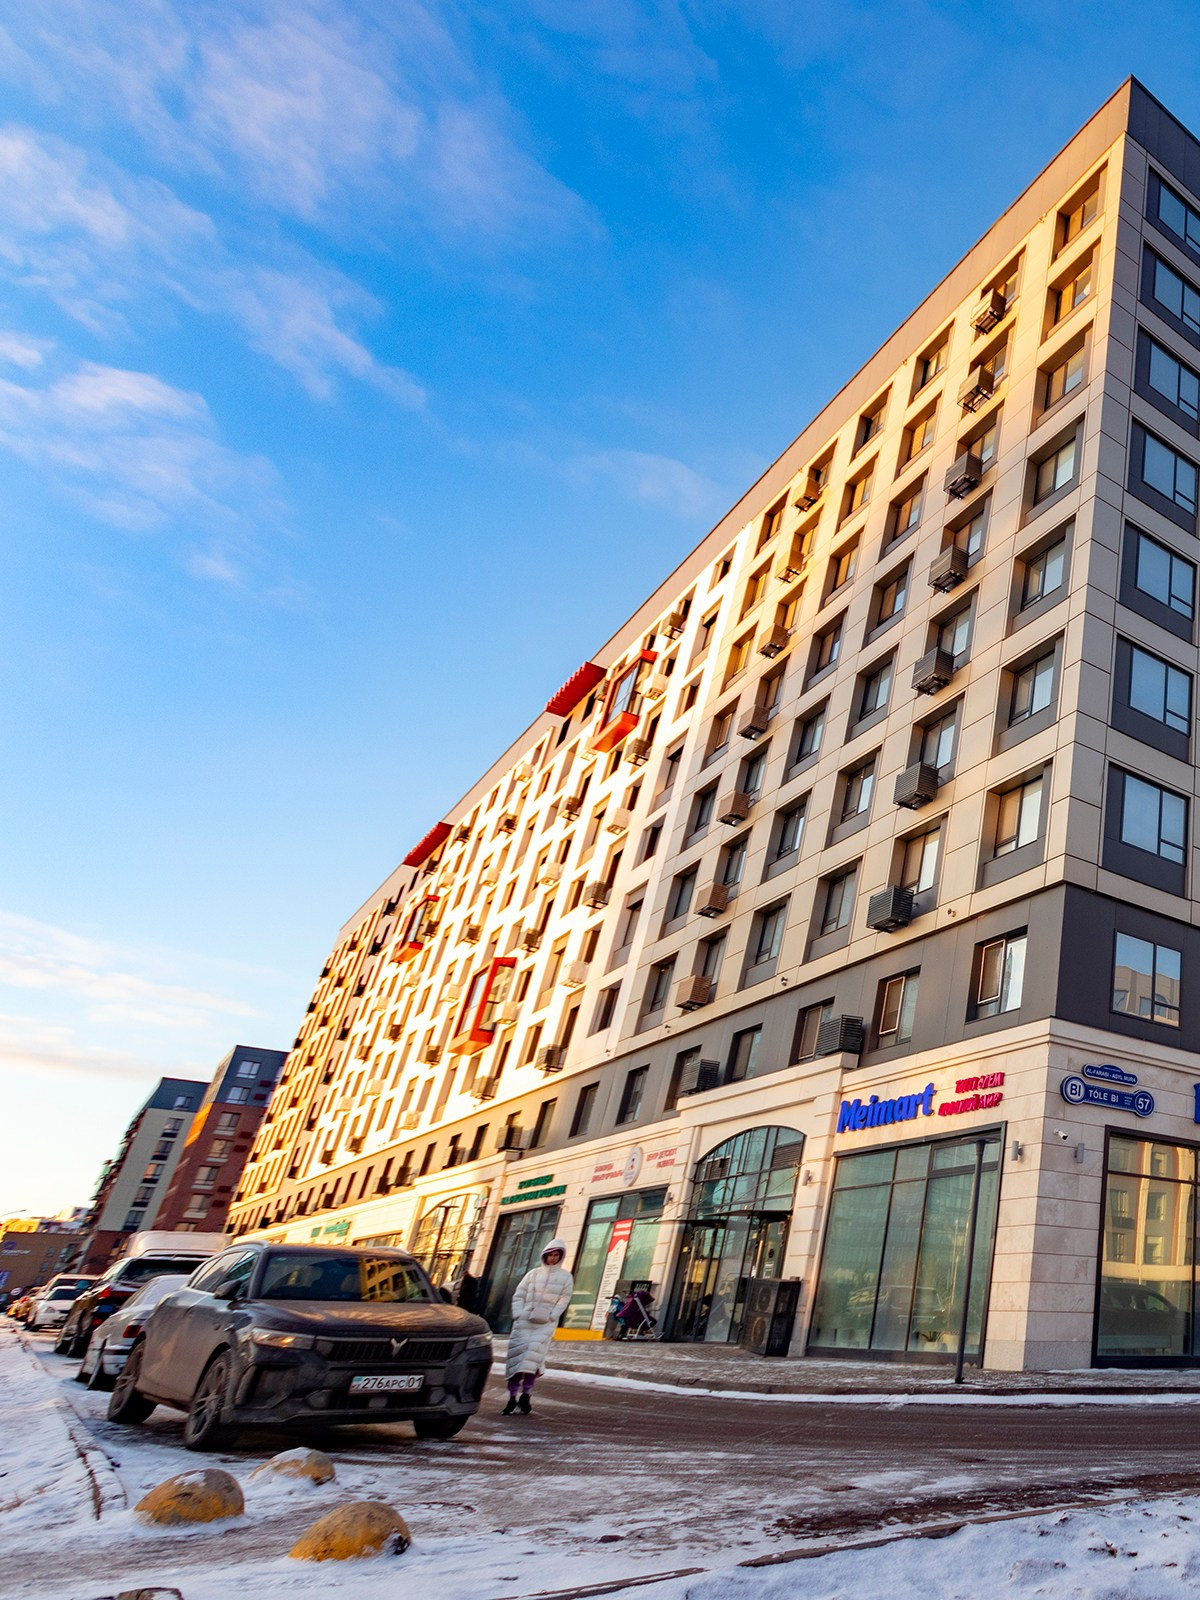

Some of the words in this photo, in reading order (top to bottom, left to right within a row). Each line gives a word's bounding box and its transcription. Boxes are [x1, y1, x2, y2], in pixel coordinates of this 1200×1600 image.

[1070, 1083, 1081, 1097] BI
[1088, 1087, 1108, 1101] TÓLE
[1110, 1094, 1119, 1103] BI
[837, 1083, 937, 1134] Meimart
[1137, 1097, 1150, 1111] 57
[361, 1377, 406, 1389] 276APC
[407, 1376, 423, 1388] 01
